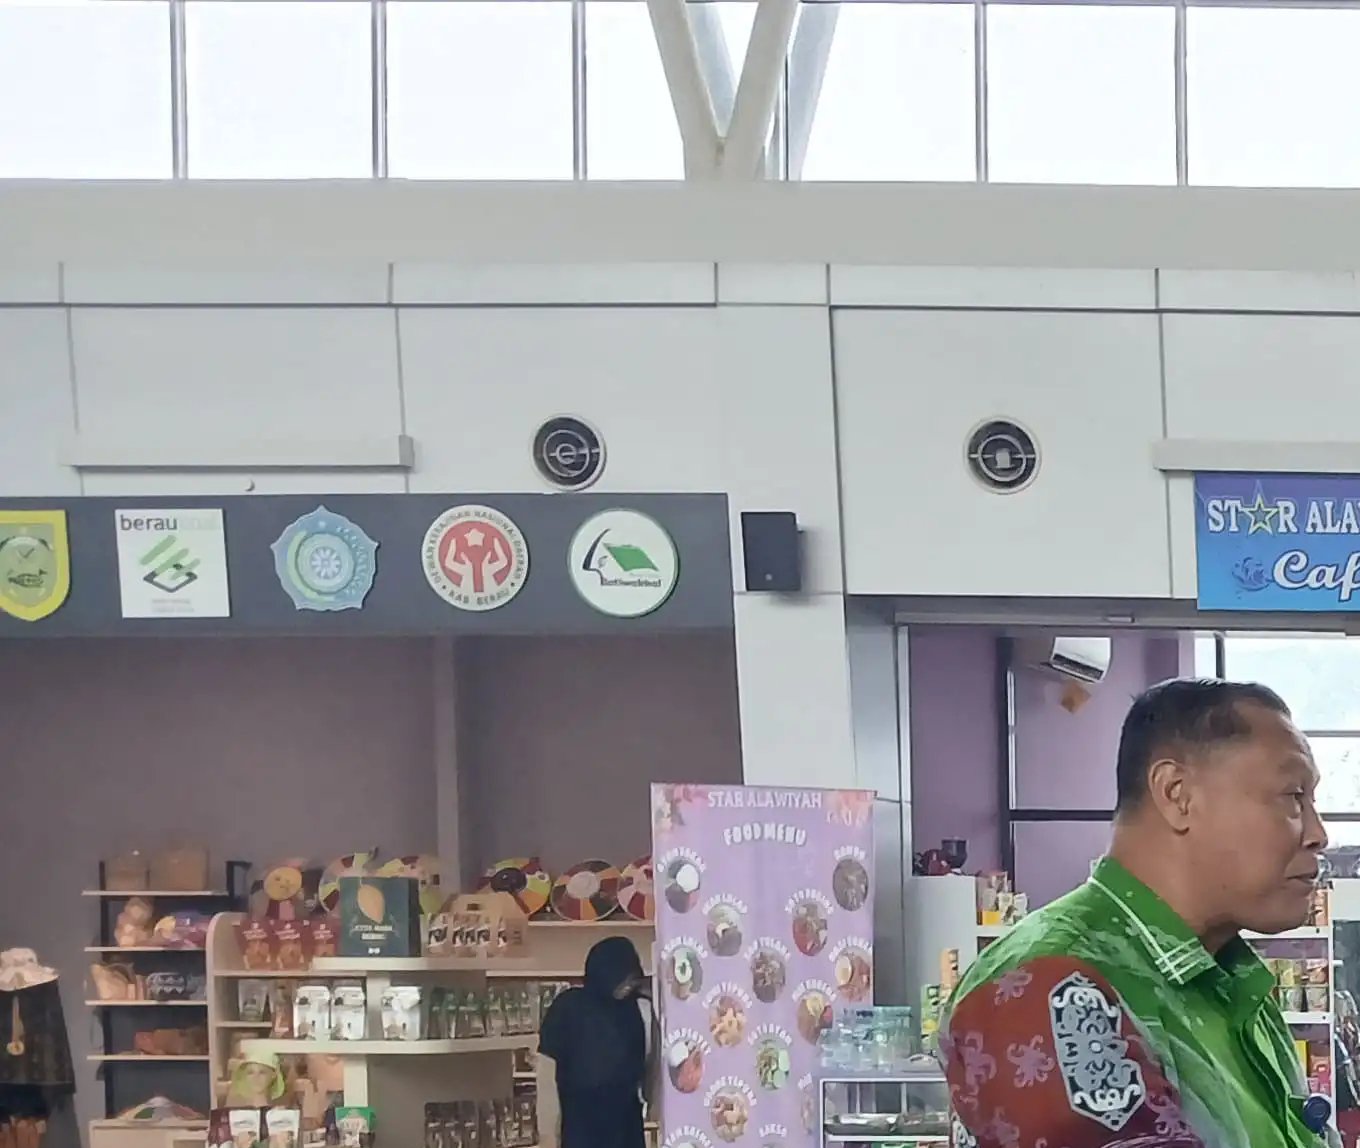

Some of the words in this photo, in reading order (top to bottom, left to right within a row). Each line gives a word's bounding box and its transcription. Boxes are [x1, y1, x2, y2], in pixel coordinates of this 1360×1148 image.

[120, 515, 178, 531] berau
[708, 791, 743, 808] STAR
[749, 792, 822, 808] ALAWIYAH
[723, 822, 761, 846] FOOD
[764, 822, 806, 846] MENU
